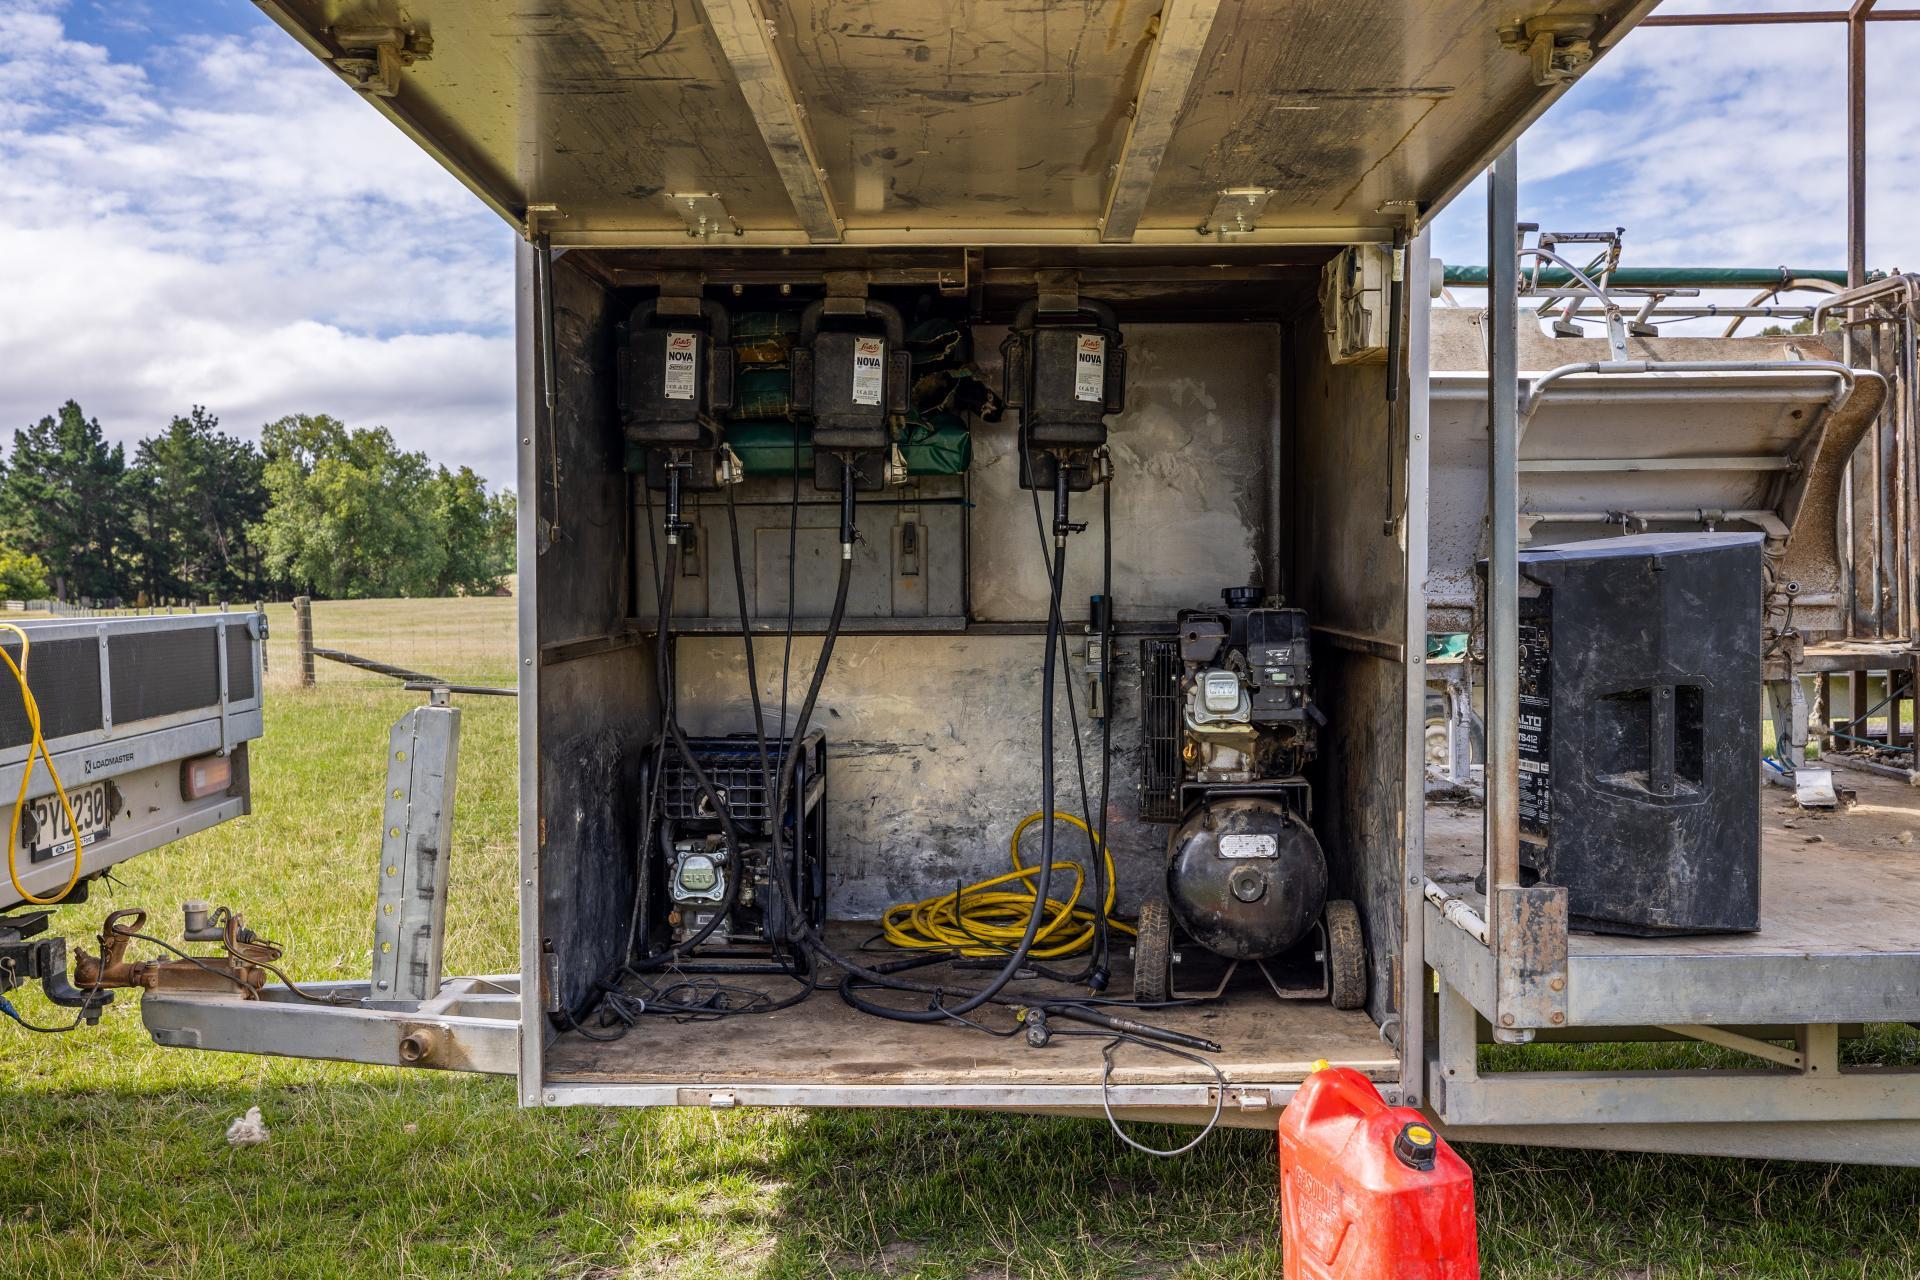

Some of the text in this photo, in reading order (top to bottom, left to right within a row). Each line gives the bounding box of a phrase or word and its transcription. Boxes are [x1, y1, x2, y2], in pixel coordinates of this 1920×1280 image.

[669, 352, 693, 361] NOVA
[1080, 353, 1101, 363] NOVA
[857, 357, 881, 367] NOVA
[92, 753, 134, 769] LOADMASTER
[36, 787, 104, 845] PYU230
